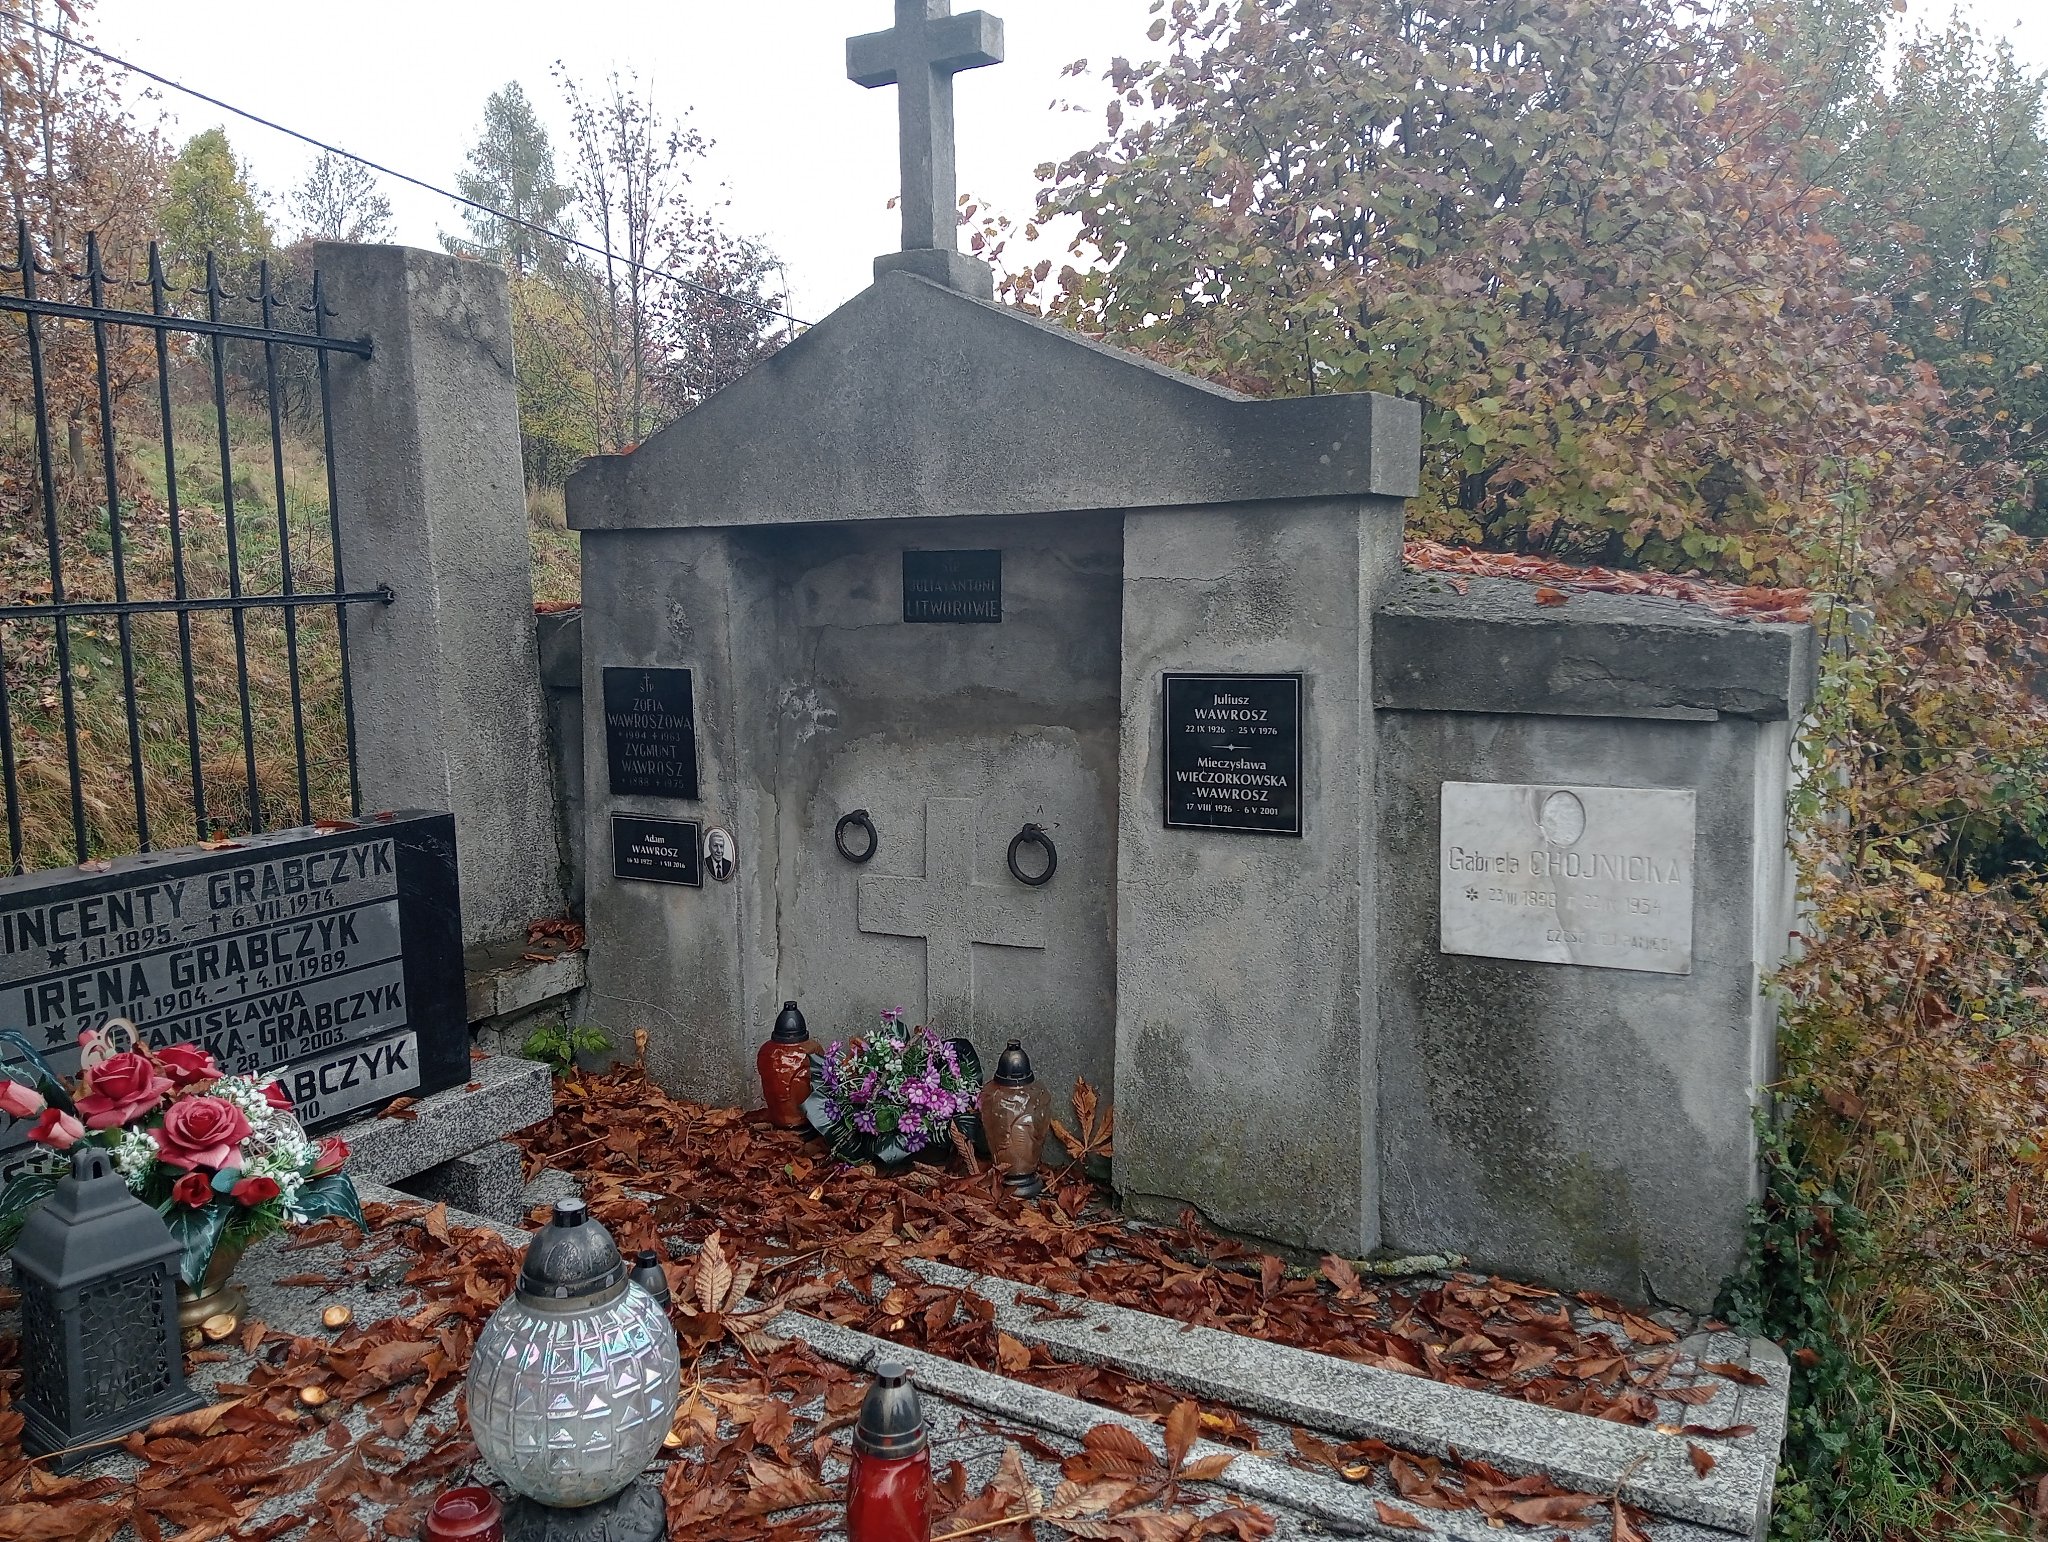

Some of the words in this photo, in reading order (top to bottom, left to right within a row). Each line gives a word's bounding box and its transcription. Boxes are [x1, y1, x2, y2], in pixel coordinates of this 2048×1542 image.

[633, 699, 665, 712] ZOFIA
[1213, 693, 1250, 706] Juliusz
[607, 712, 693, 731] WAWROSZOWA
[1194, 708, 1268, 721] WAWROSZ
[1185, 725, 1195, 733] 22
[1196, 725, 1206, 733] IX
[1207, 725, 1226, 734] 1926
[1238, 726, 1248, 734] 25
[1259, 727, 1278, 735] 1976
[624, 743, 678, 758] ZYGMUNT
[621, 759, 684, 777] WAWROSZ
[1197, 757, 1267, 771] Mieczysława
[1176, 771, 1288, 787] WIECZORKOWSKA
[1192, 787, 1269, 801] -WAWROSZ
[1186, 803, 1194, 811] 17
[1197, 803, 1212, 812] VIII
[1215, 804, 1233, 813] 1926
[1244, 806, 1250, 814] 6
[1251, 806, 1258, 814] V
[1260, 807, 1279, 815] 2001
[644, 834, 665, 844] Adam
[631, 844, 679, 858] WAWROSZ
[1529, 850, 1682, 885] CHOJNICKA
[207, 841, 392, 910] GRABCZYK
[24, 962, 151, 1027] IRENA
[169, 911, 359, 989] GRABCZYK
[112, 990, 306, 1056] ANISŁAWA
[189, 981, 403, 1062] KA-GRABCZYK
